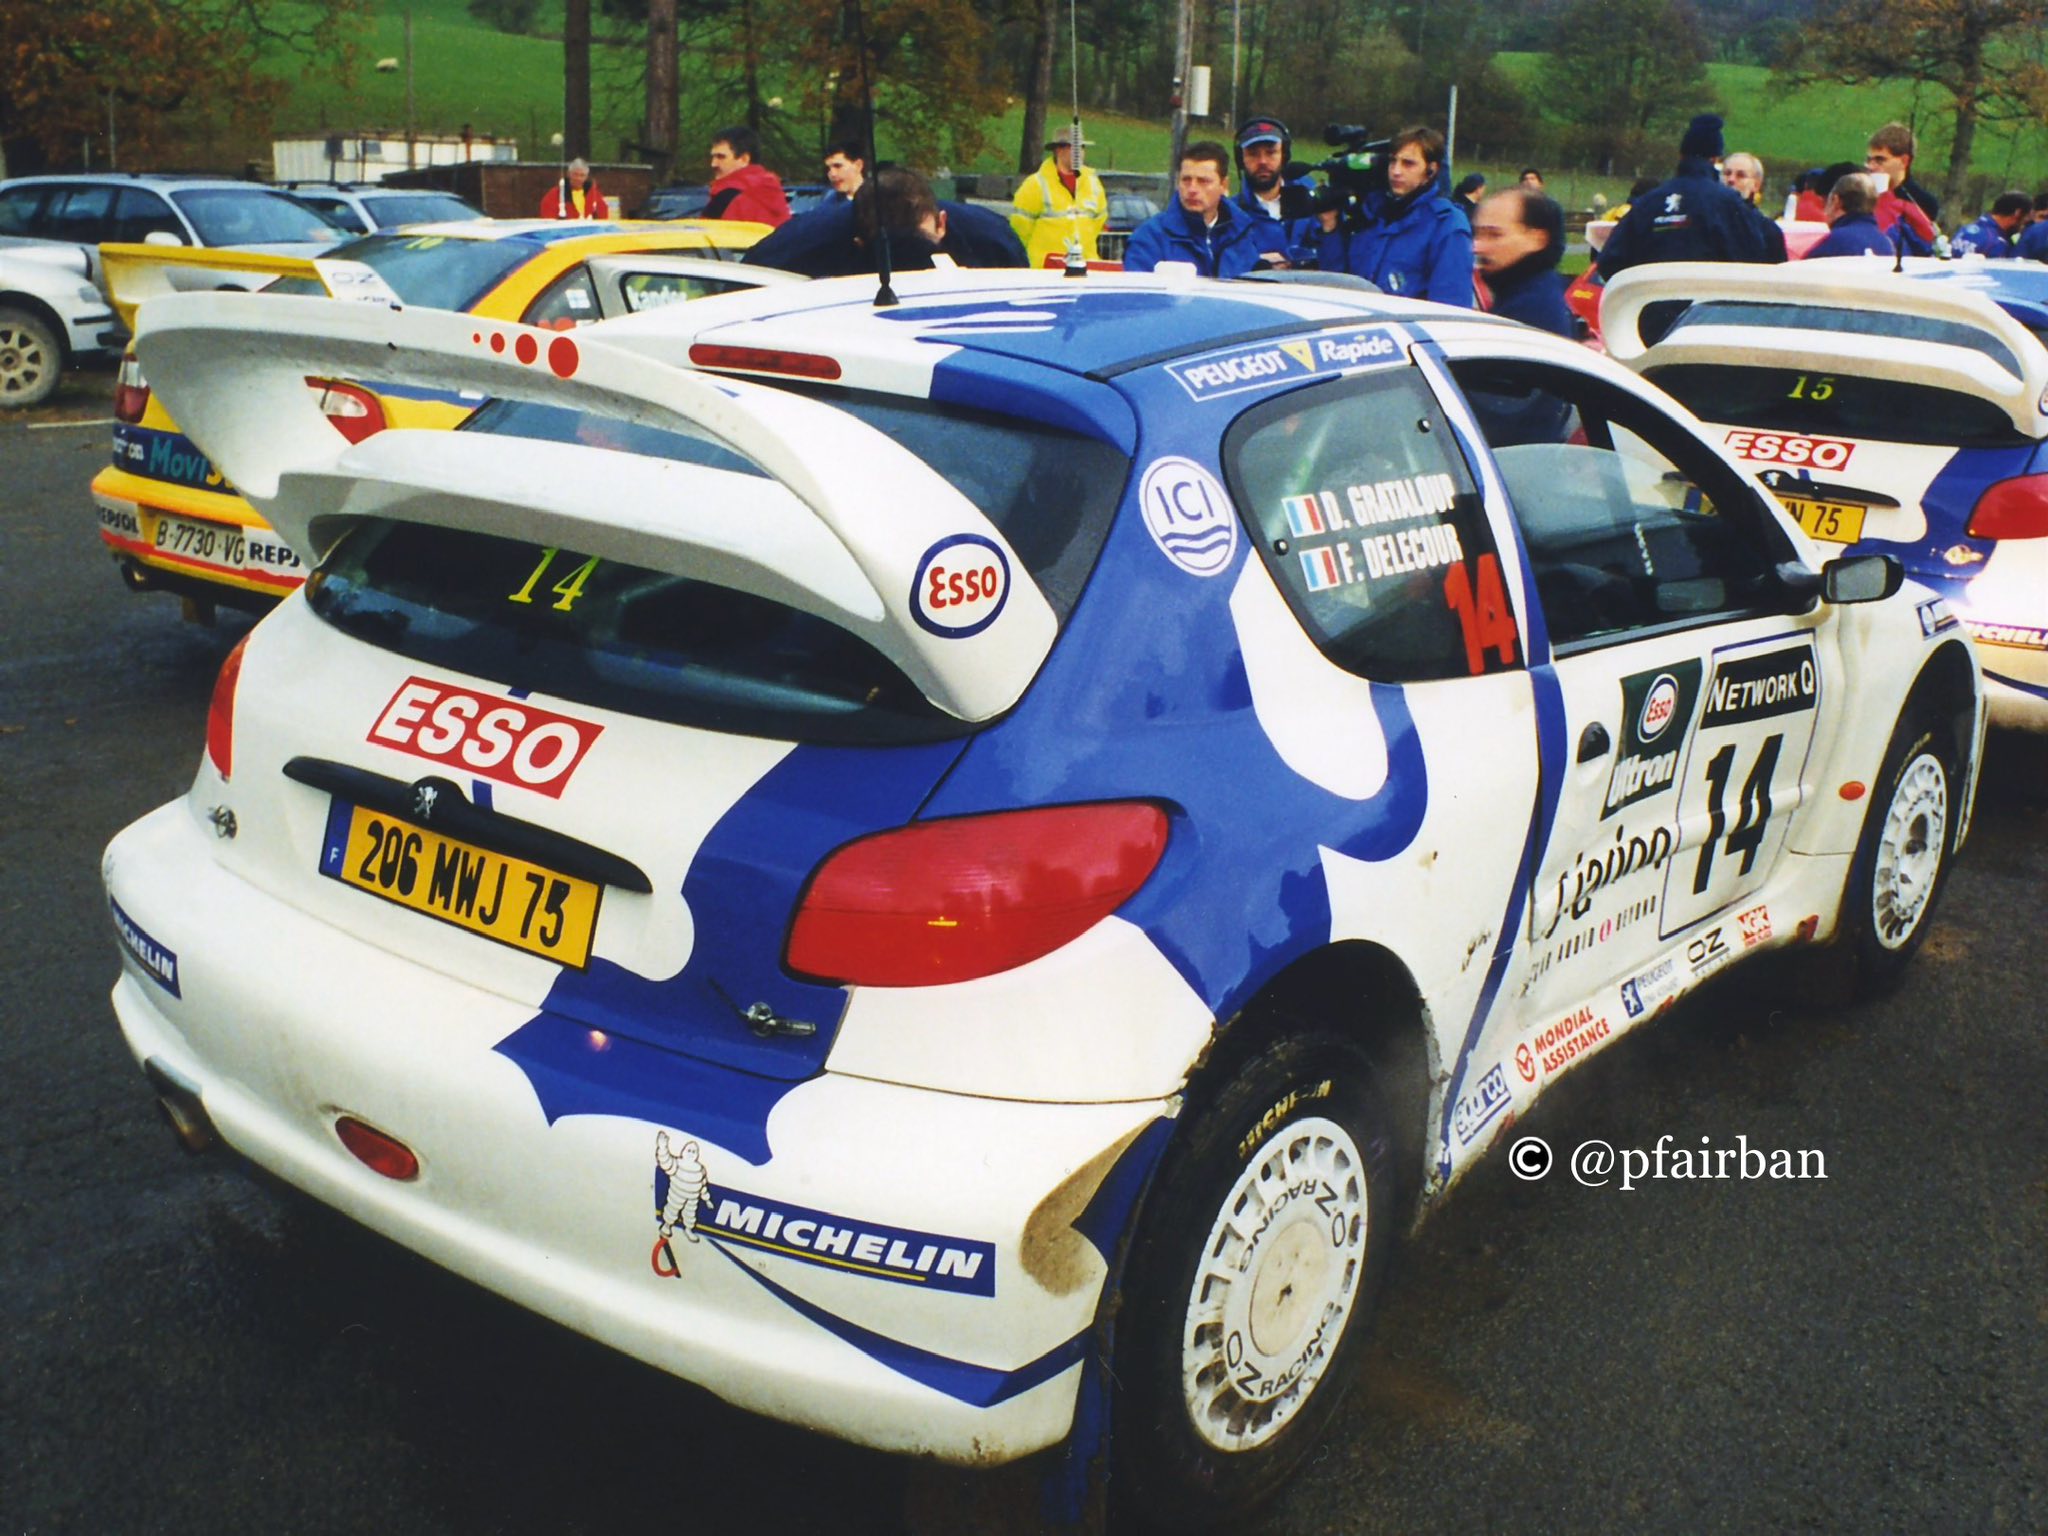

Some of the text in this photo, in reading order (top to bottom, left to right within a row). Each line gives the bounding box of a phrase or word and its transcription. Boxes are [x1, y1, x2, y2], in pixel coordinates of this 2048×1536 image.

[1184, 335, 1393, 389] PEUGEOT Rapide
[1787, 376, 1836, 400] 15
[1727, 434, 1848, 468] ESSO
[1156, 479, 1216, 525] ICI
[1320, 473, 1456, 531] D. GRATALOUP
[1814, 505, 1843, 536] 75
[1337, 523, 1464, 584] F. DELECOUR
[508, 547, 601, 612] 14
[930, 566, 997, 609] Esso
[1444, 553, 1517, 675] 14
[1801, 660, 1815, 695] Q
[374, 683, 581, 785] ESSO
[1646, 697, 1672, 722] Esso
[1693, 733, 1784, 895] 14
[329, 846, 340, 864] F
[359, 818, 571, 948] 206 MWJ 75
[1687, 927, 1725, 963] OZ
[1534, 1005, 1594, 1054] MONDIAL
[1542, 1017, 1611, 1075] ASSISTANCE
[714, 1199, 983, 1280] MICHELIN
